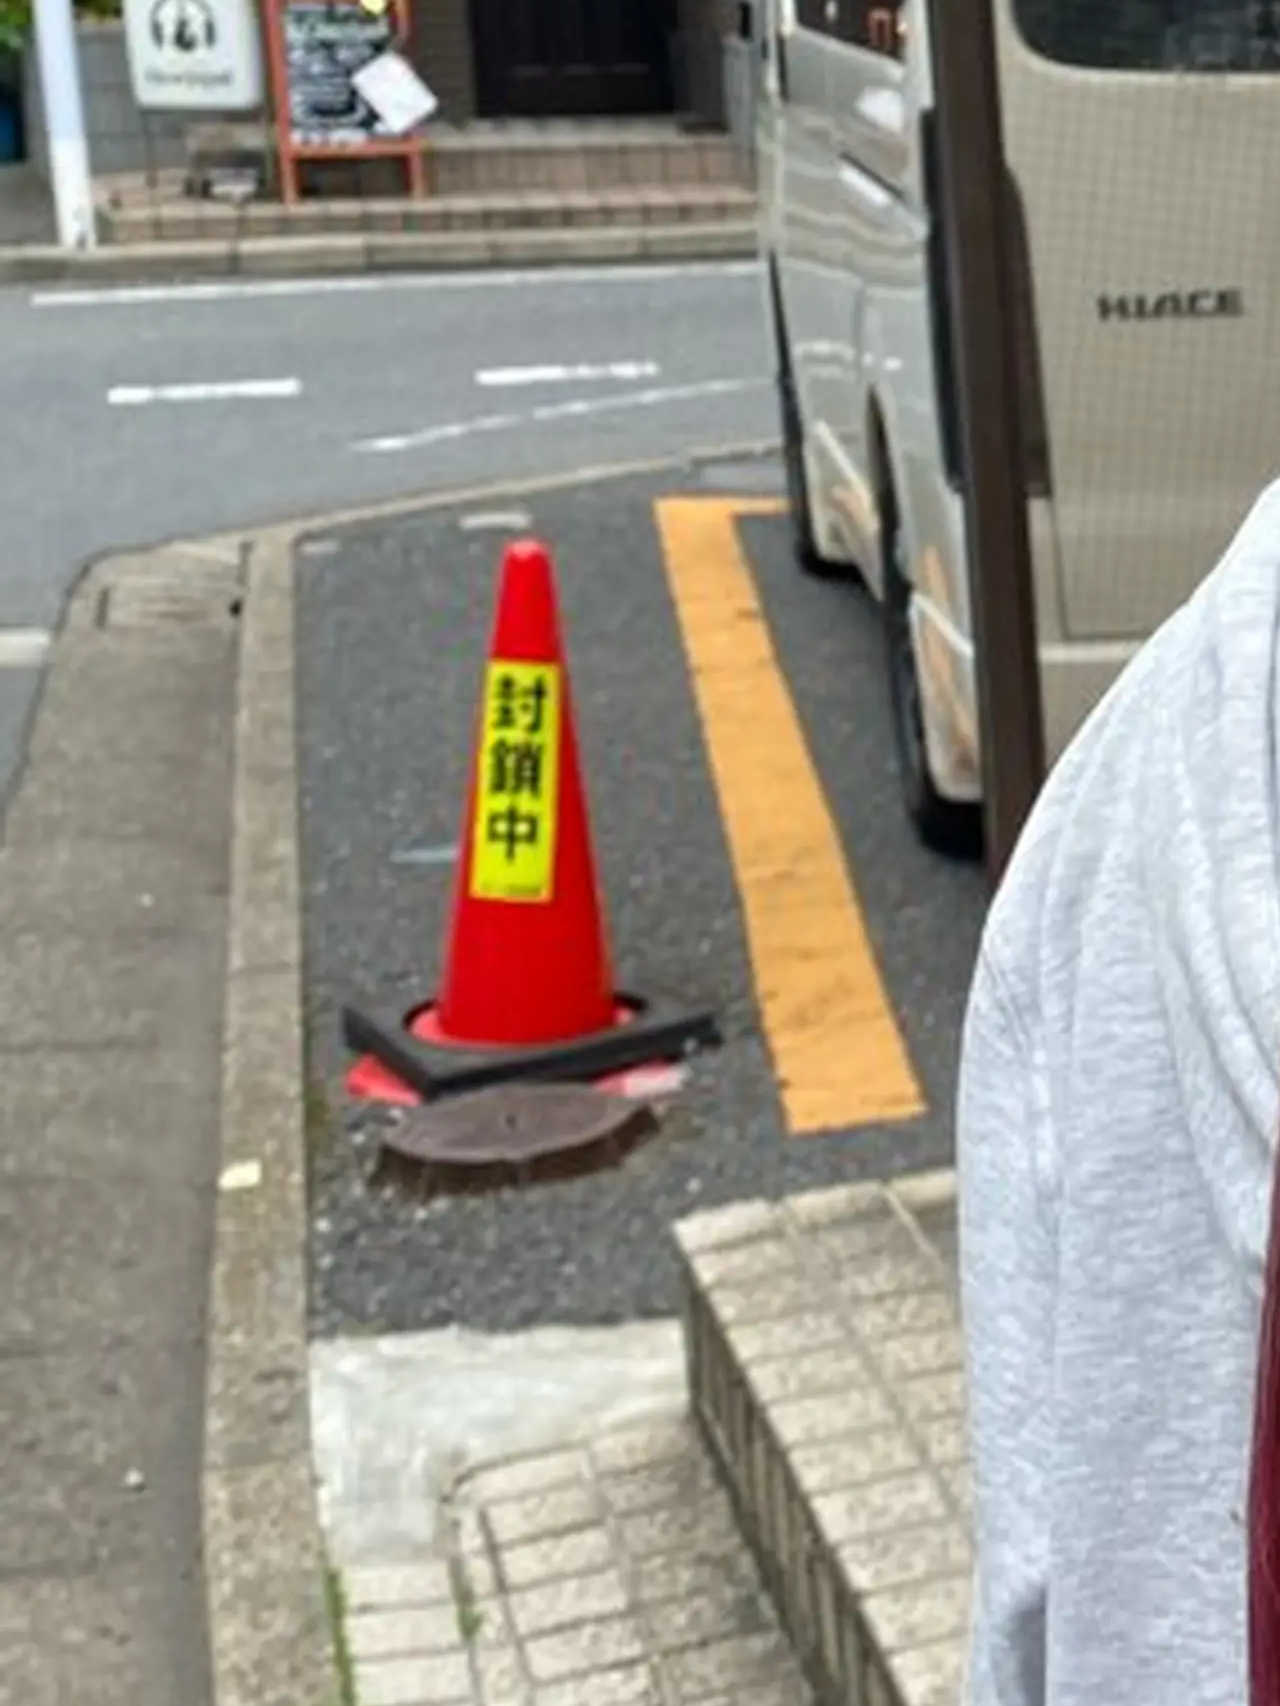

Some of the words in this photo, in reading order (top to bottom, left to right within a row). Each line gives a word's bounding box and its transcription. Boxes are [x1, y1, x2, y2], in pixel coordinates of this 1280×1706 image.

[1097, 290, 1243, 323] HIACE
[488, 673, 547, 863] 封鎖中
